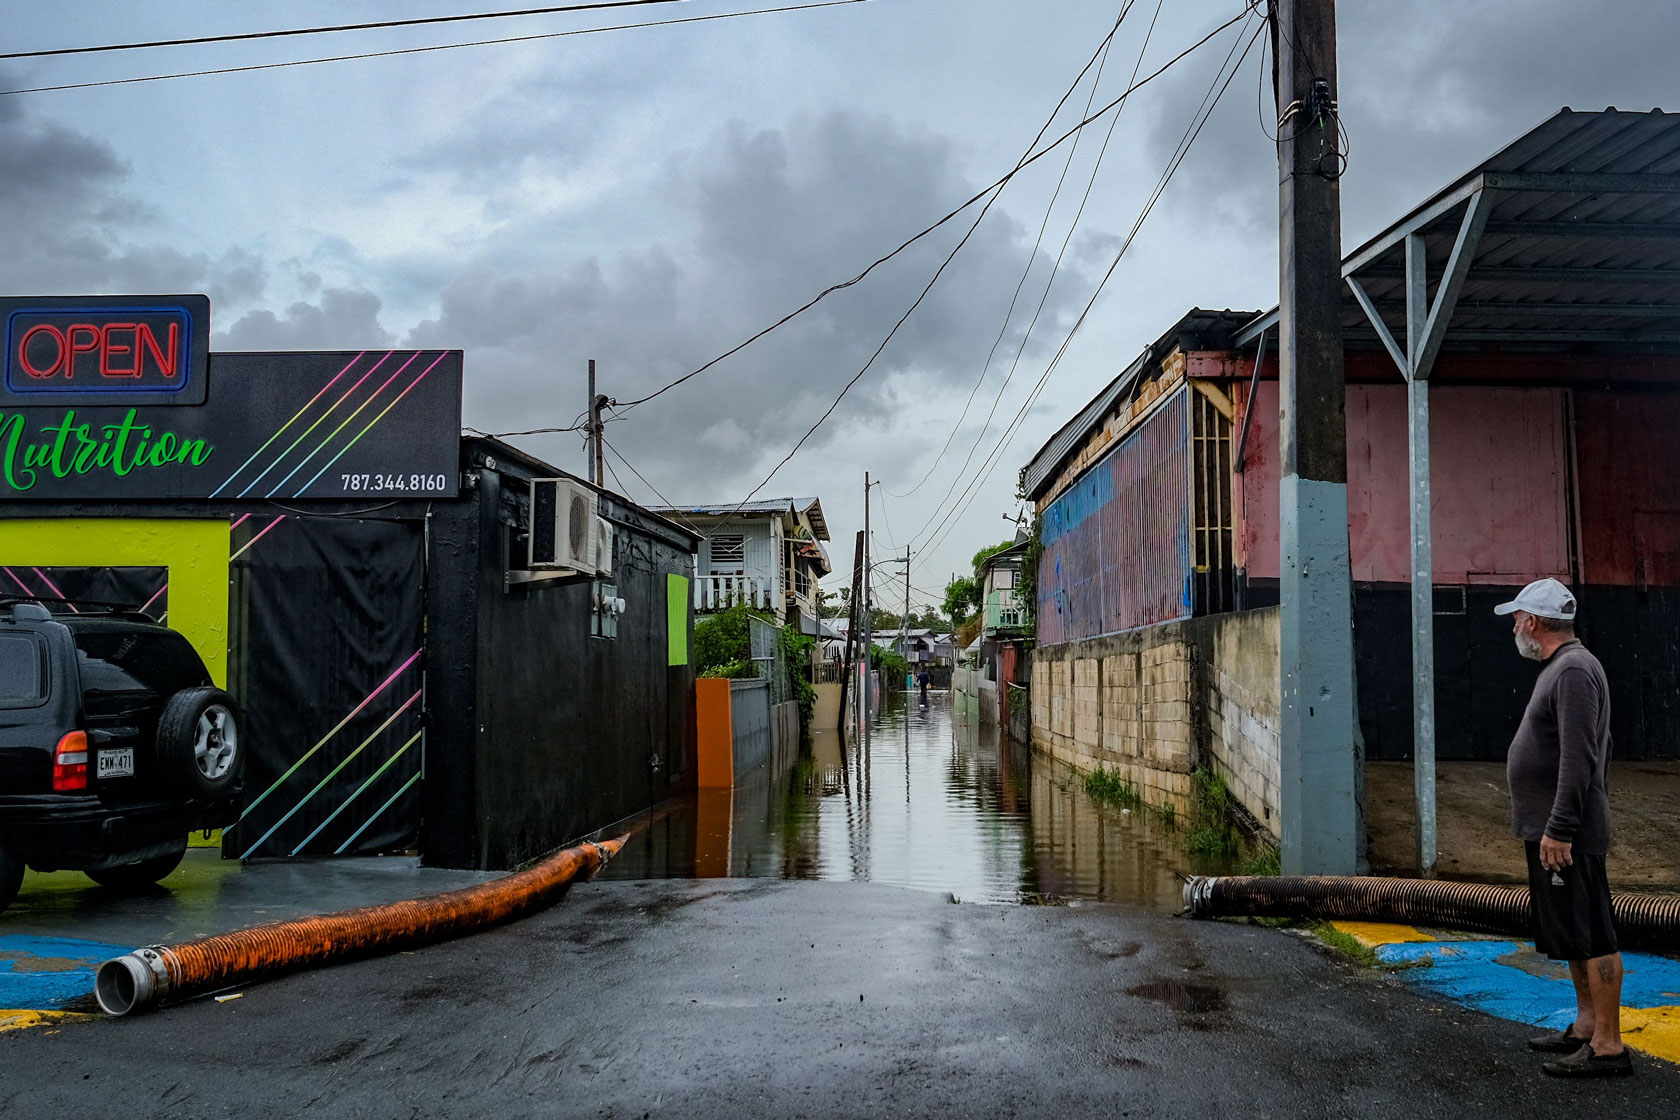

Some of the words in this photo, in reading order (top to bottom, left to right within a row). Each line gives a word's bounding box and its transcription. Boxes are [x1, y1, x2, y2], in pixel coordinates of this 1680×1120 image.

[19, 322, 178, 379] OPEN
[0, 408, 214, 491] Nutrition
[341, 474, 446, 491] 787.344.8160
